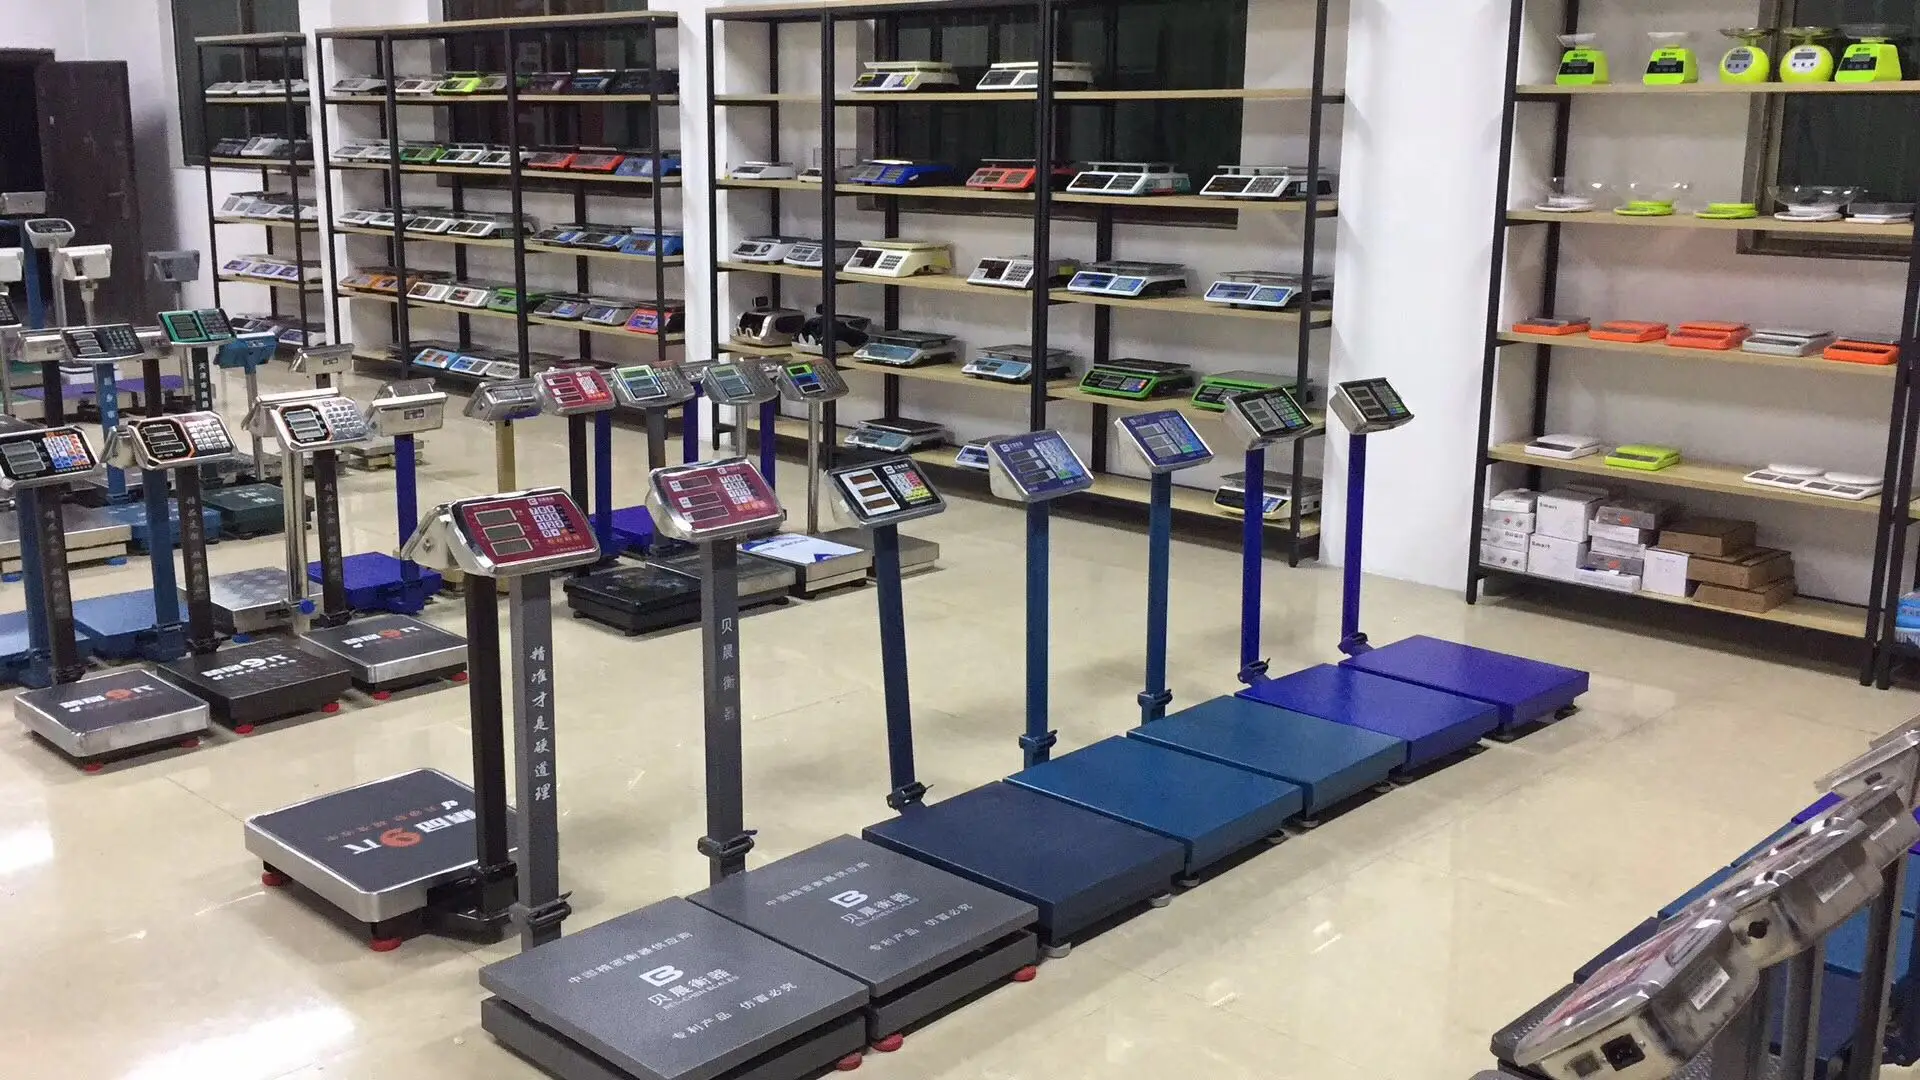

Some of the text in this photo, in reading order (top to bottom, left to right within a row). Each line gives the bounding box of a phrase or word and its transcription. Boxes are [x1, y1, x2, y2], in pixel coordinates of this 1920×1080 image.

[530, 645, 551, 801] 精准才是硬道理
[648, 968, 731, 1006] 贝晨衡器
